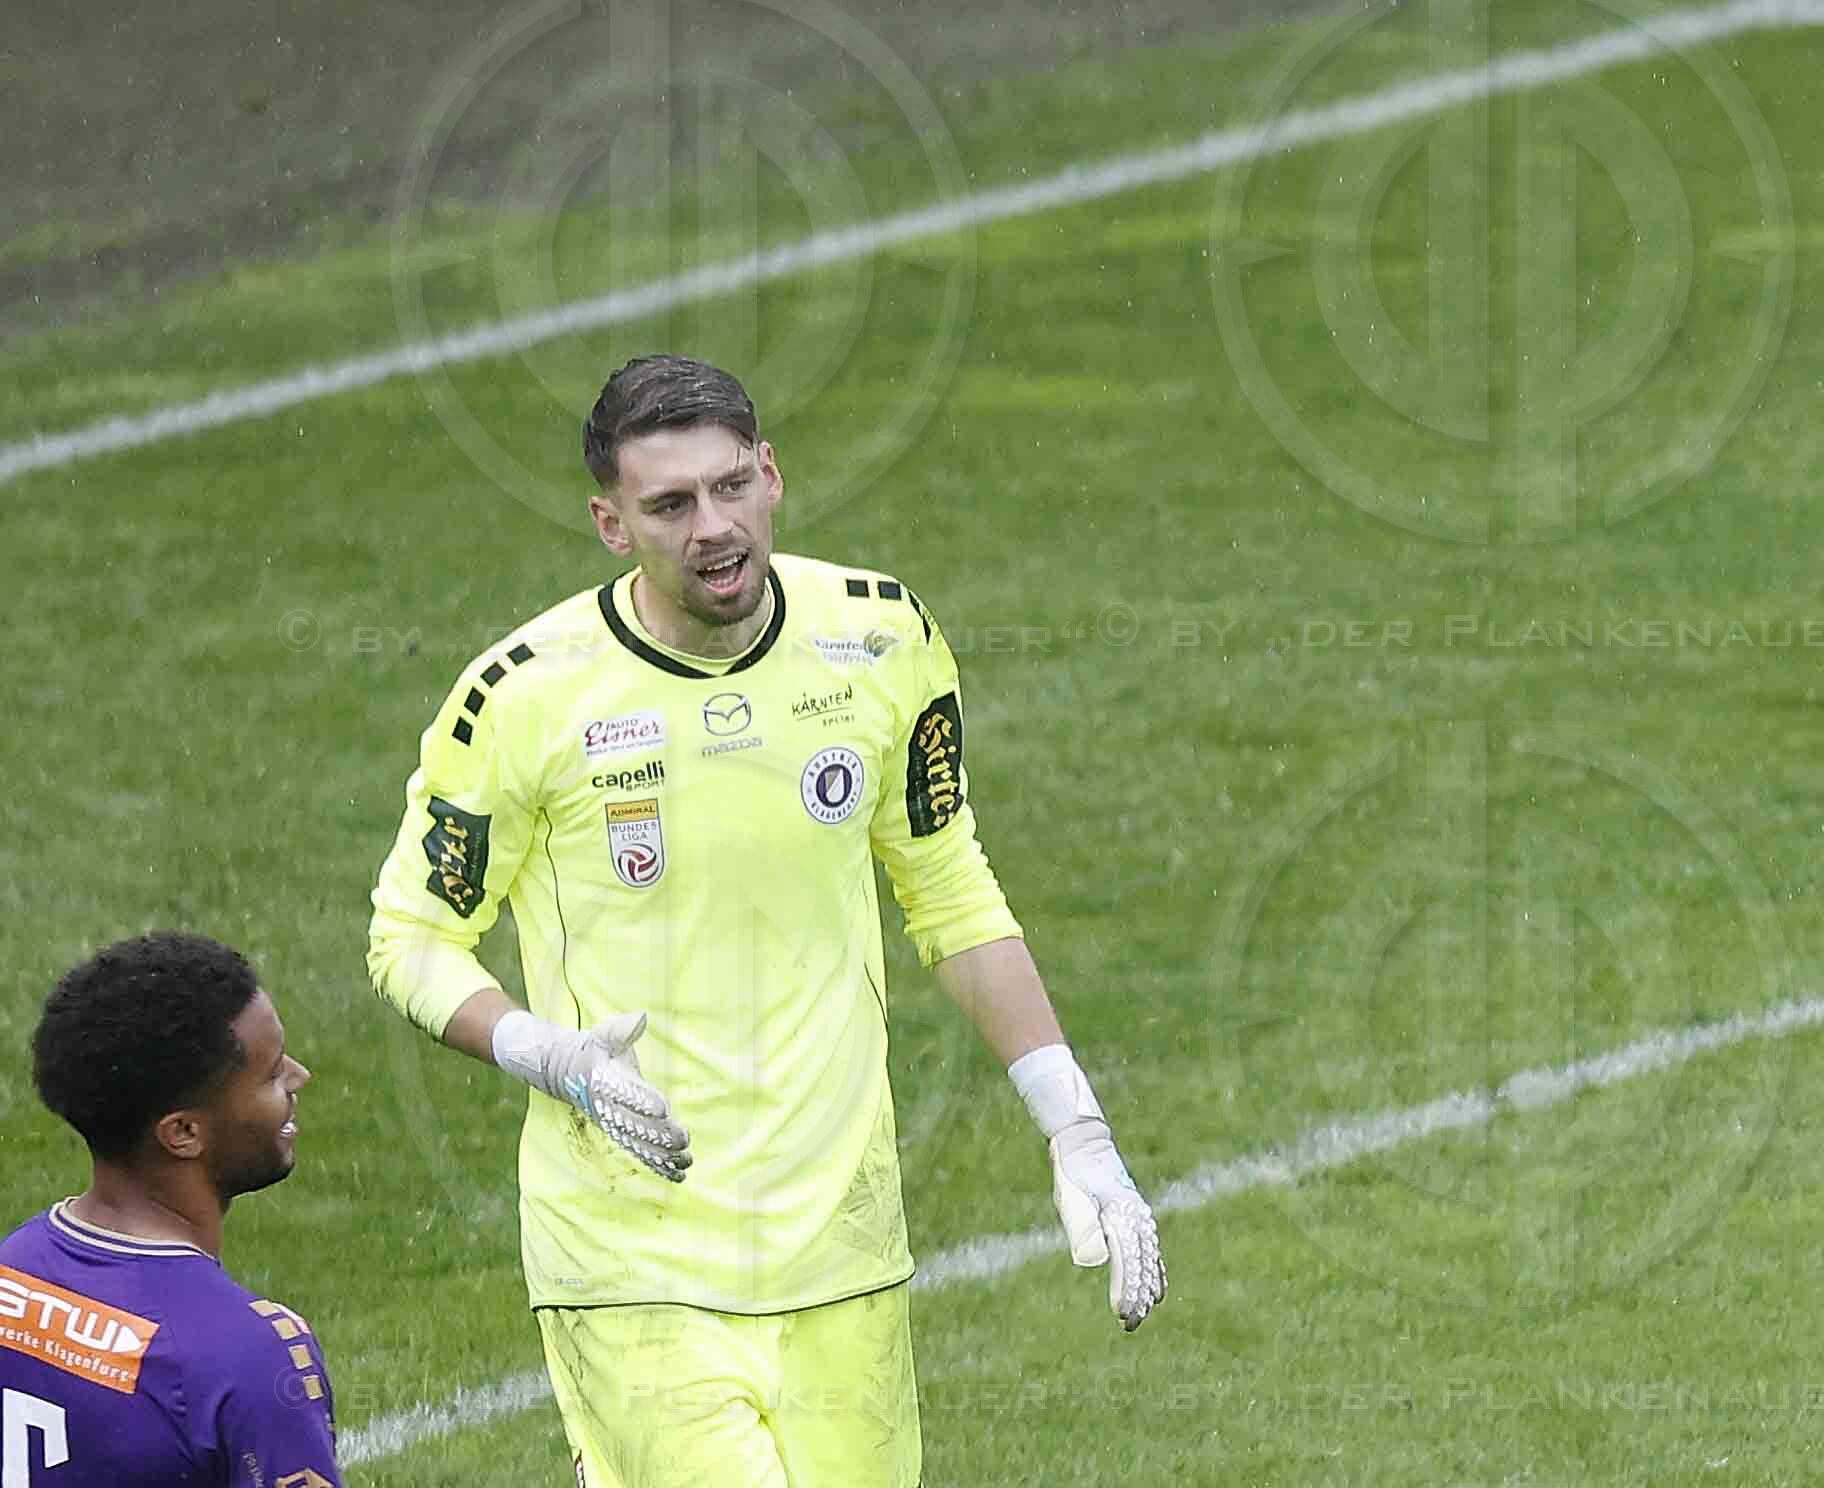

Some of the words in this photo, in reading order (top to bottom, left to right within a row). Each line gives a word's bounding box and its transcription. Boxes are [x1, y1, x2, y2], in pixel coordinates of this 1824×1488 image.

[592, 760, 665, 790] capelli
[611, 821, 658, 834] BUNDES
[621, 830, 649, 842] LIGA
